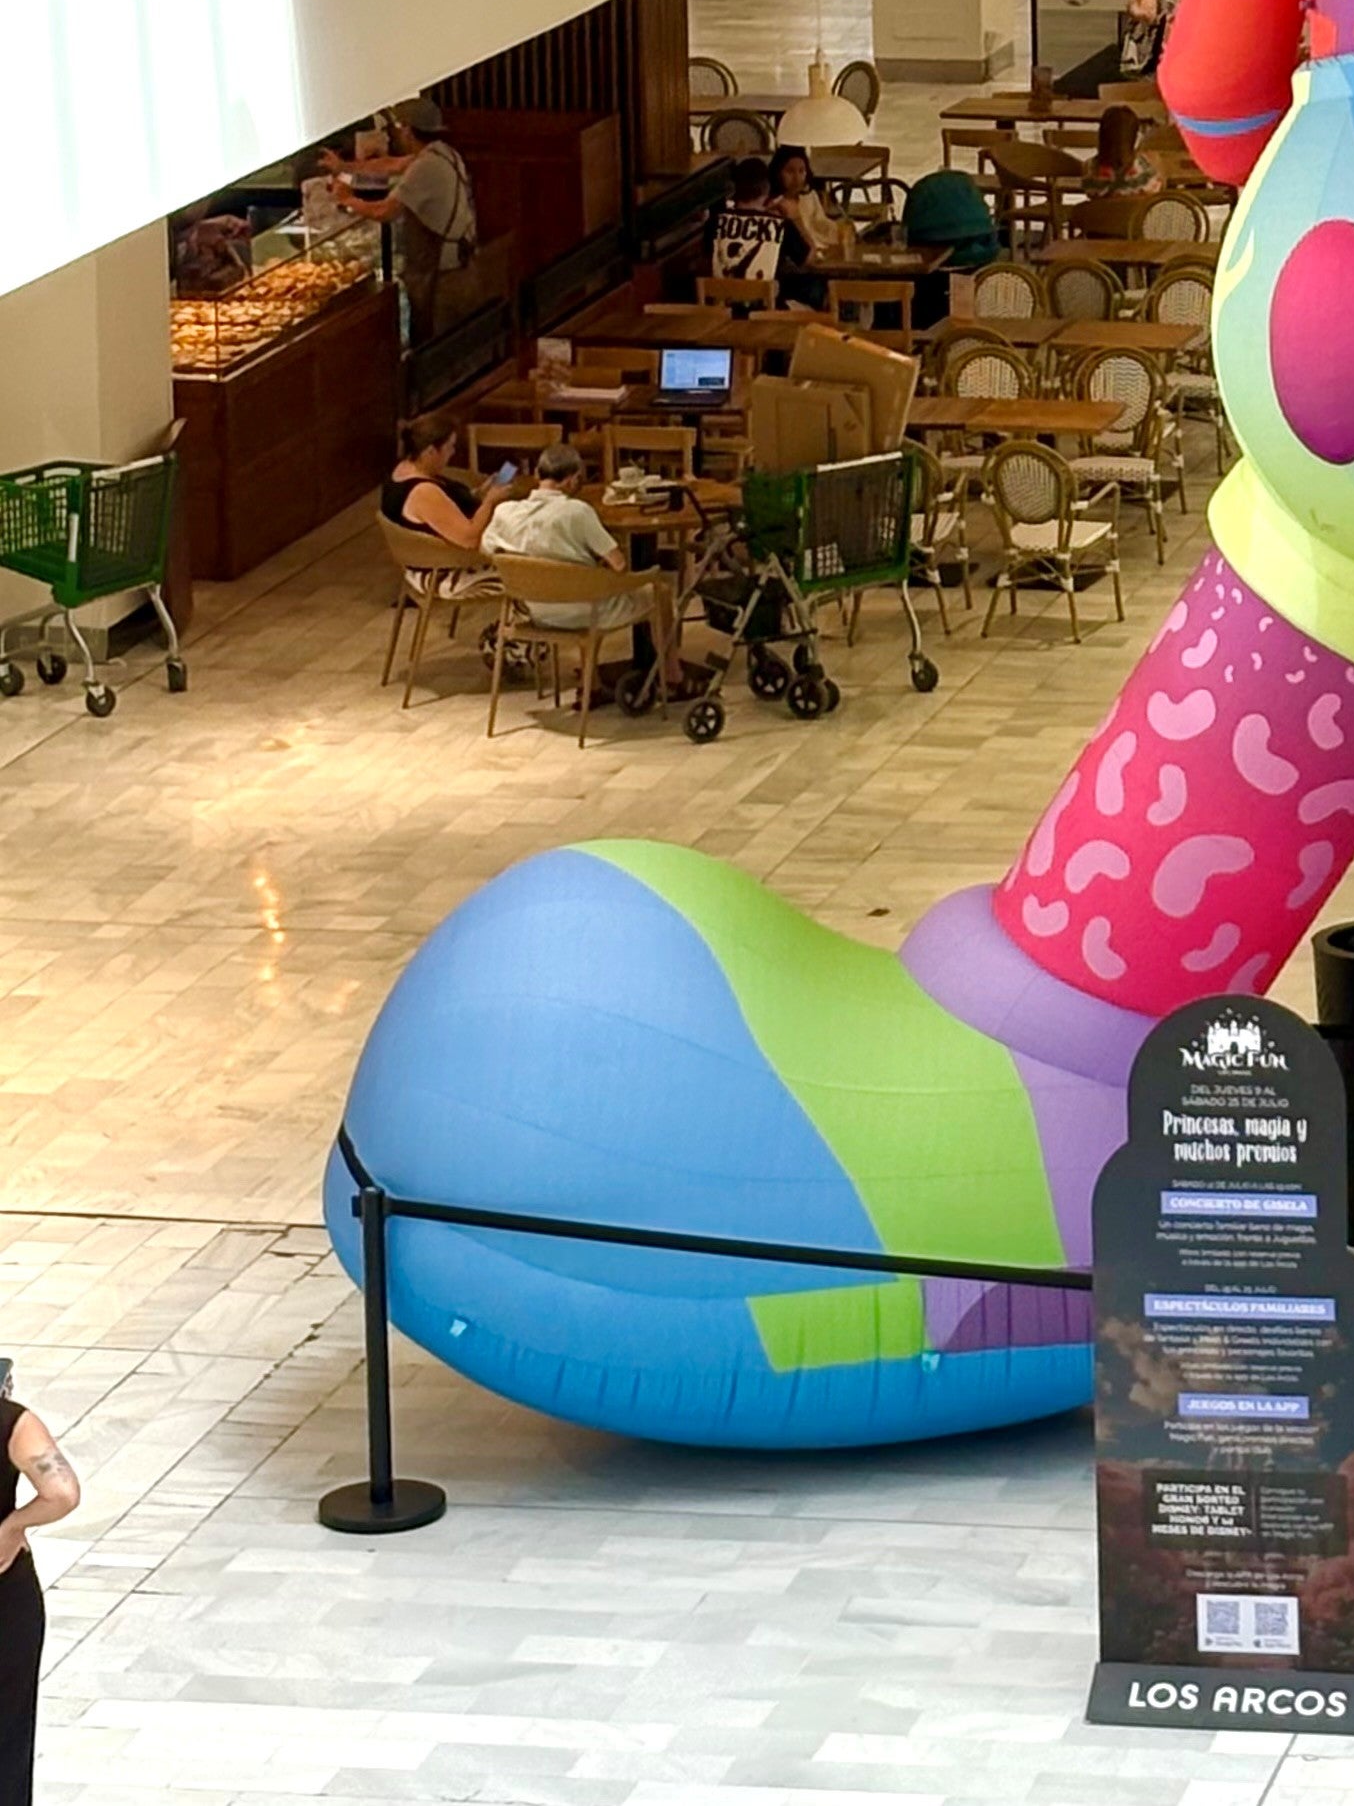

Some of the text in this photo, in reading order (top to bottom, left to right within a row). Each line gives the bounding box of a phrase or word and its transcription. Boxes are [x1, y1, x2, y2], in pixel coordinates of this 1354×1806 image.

[717, 216, 785, 244] ROCKY
[1245, 1115, 1291, 1141] magia
[1296, 1118, 1308, 1143] y
[1173, 1138, 1298, 1168] muchos premios
[1169, 1197, 1243, 1210] CONCIERTO
[1243, 1198, 1261, 1210] DE
[1187, 1398, 1236, 1411] JUEGOS
[1128, 1681, 1348, 1718] LOS ARCOS
